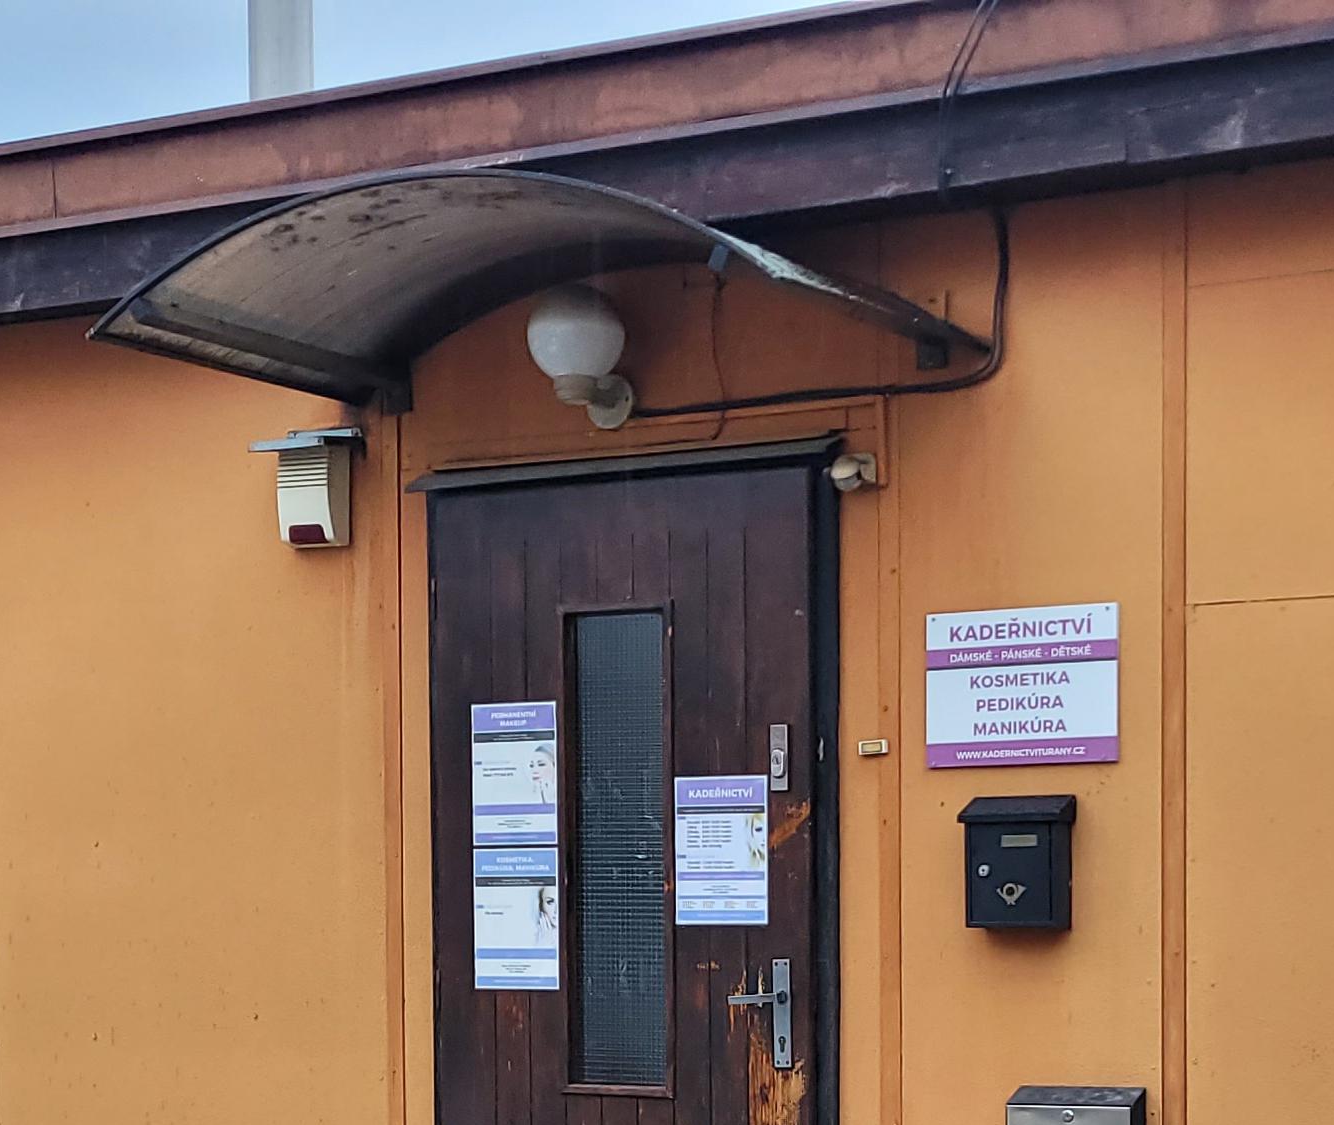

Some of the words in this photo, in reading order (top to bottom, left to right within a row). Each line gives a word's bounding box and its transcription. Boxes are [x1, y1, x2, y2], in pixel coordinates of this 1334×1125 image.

[949, 613, 1092, 643] KADEŘNICTVÍ
[949, 650, 993, 663] DÁMSKÉ
[1000, 647, 1043, 661] PÁNSKÉ
[1050, 644, 1092, 657] DĚTSKÉ
[969, 671, 1071, 690] KOSMETIKA
[975, 693, 1065, 712] PEDIKÚRA
[973, 716, 1067, 736] MANIKÚRA
[688, 786, 754, 799] KADEŘNICTVÍ
